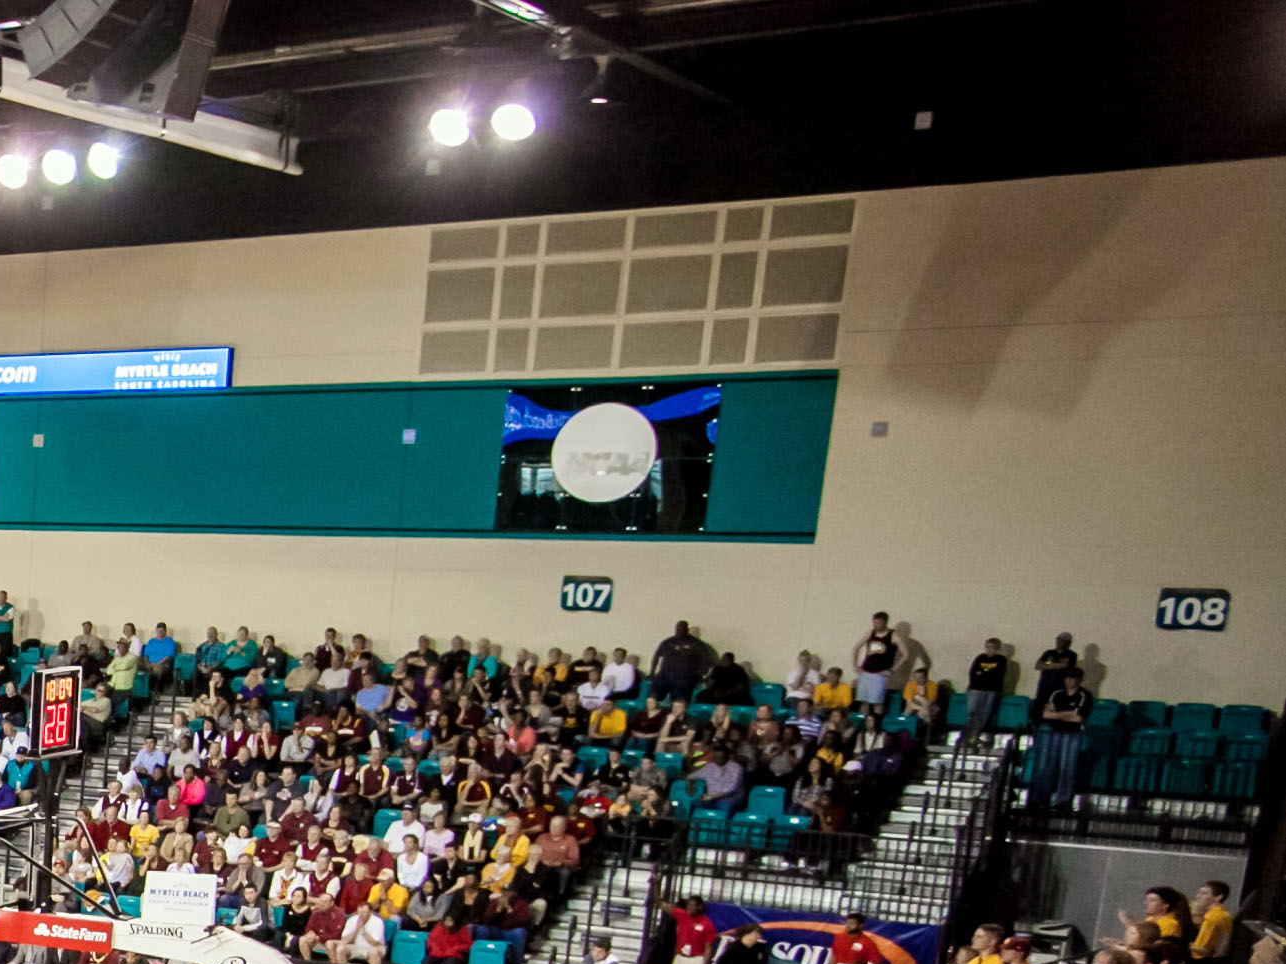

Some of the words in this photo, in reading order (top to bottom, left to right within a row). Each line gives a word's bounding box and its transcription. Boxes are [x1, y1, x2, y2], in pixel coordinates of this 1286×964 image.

[114, 365, 168, 378] MYRTLE
[171, 363, 218, 377] BEACH
[563, 583, 612, 608] 107
[1158, 597, 1226, 626] 108
[45, 675, 73, 702] 18:09
[43, 703, 71, 748] 28
[182, 890, 209, 898] BEACH
[128, 924, 184, 940] SPALDING
